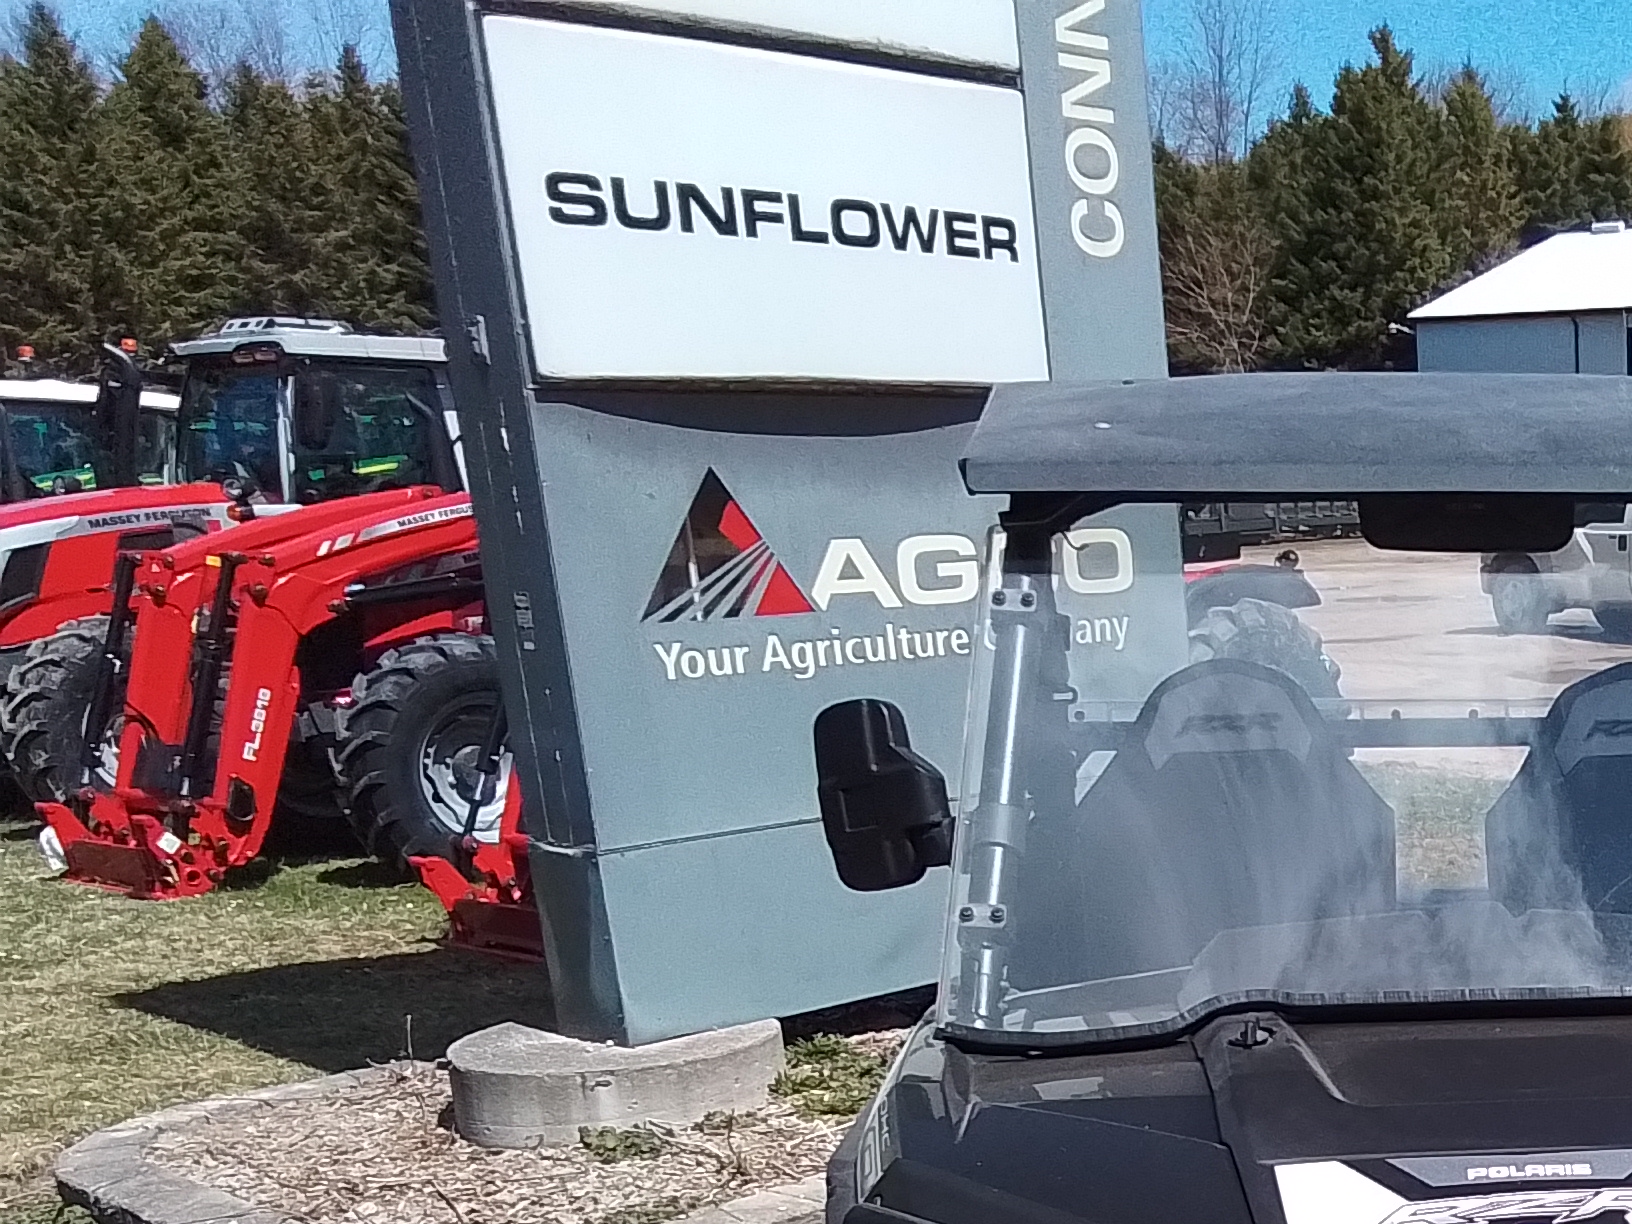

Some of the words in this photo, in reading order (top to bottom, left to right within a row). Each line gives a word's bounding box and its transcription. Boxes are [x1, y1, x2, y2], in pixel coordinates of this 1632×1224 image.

[544, 170, 1020, 263] SUNFLOWER
[88, 513, 141, 529] MASSEY
[397, 512, 436, 528] MASSEY
[811, 528, 1133, 610] AGO
[653, 640, 750, 681] Your
[761, 623, 971, 680] Agriculture
[1467, 1163, 1593, 1181] POLARIS
